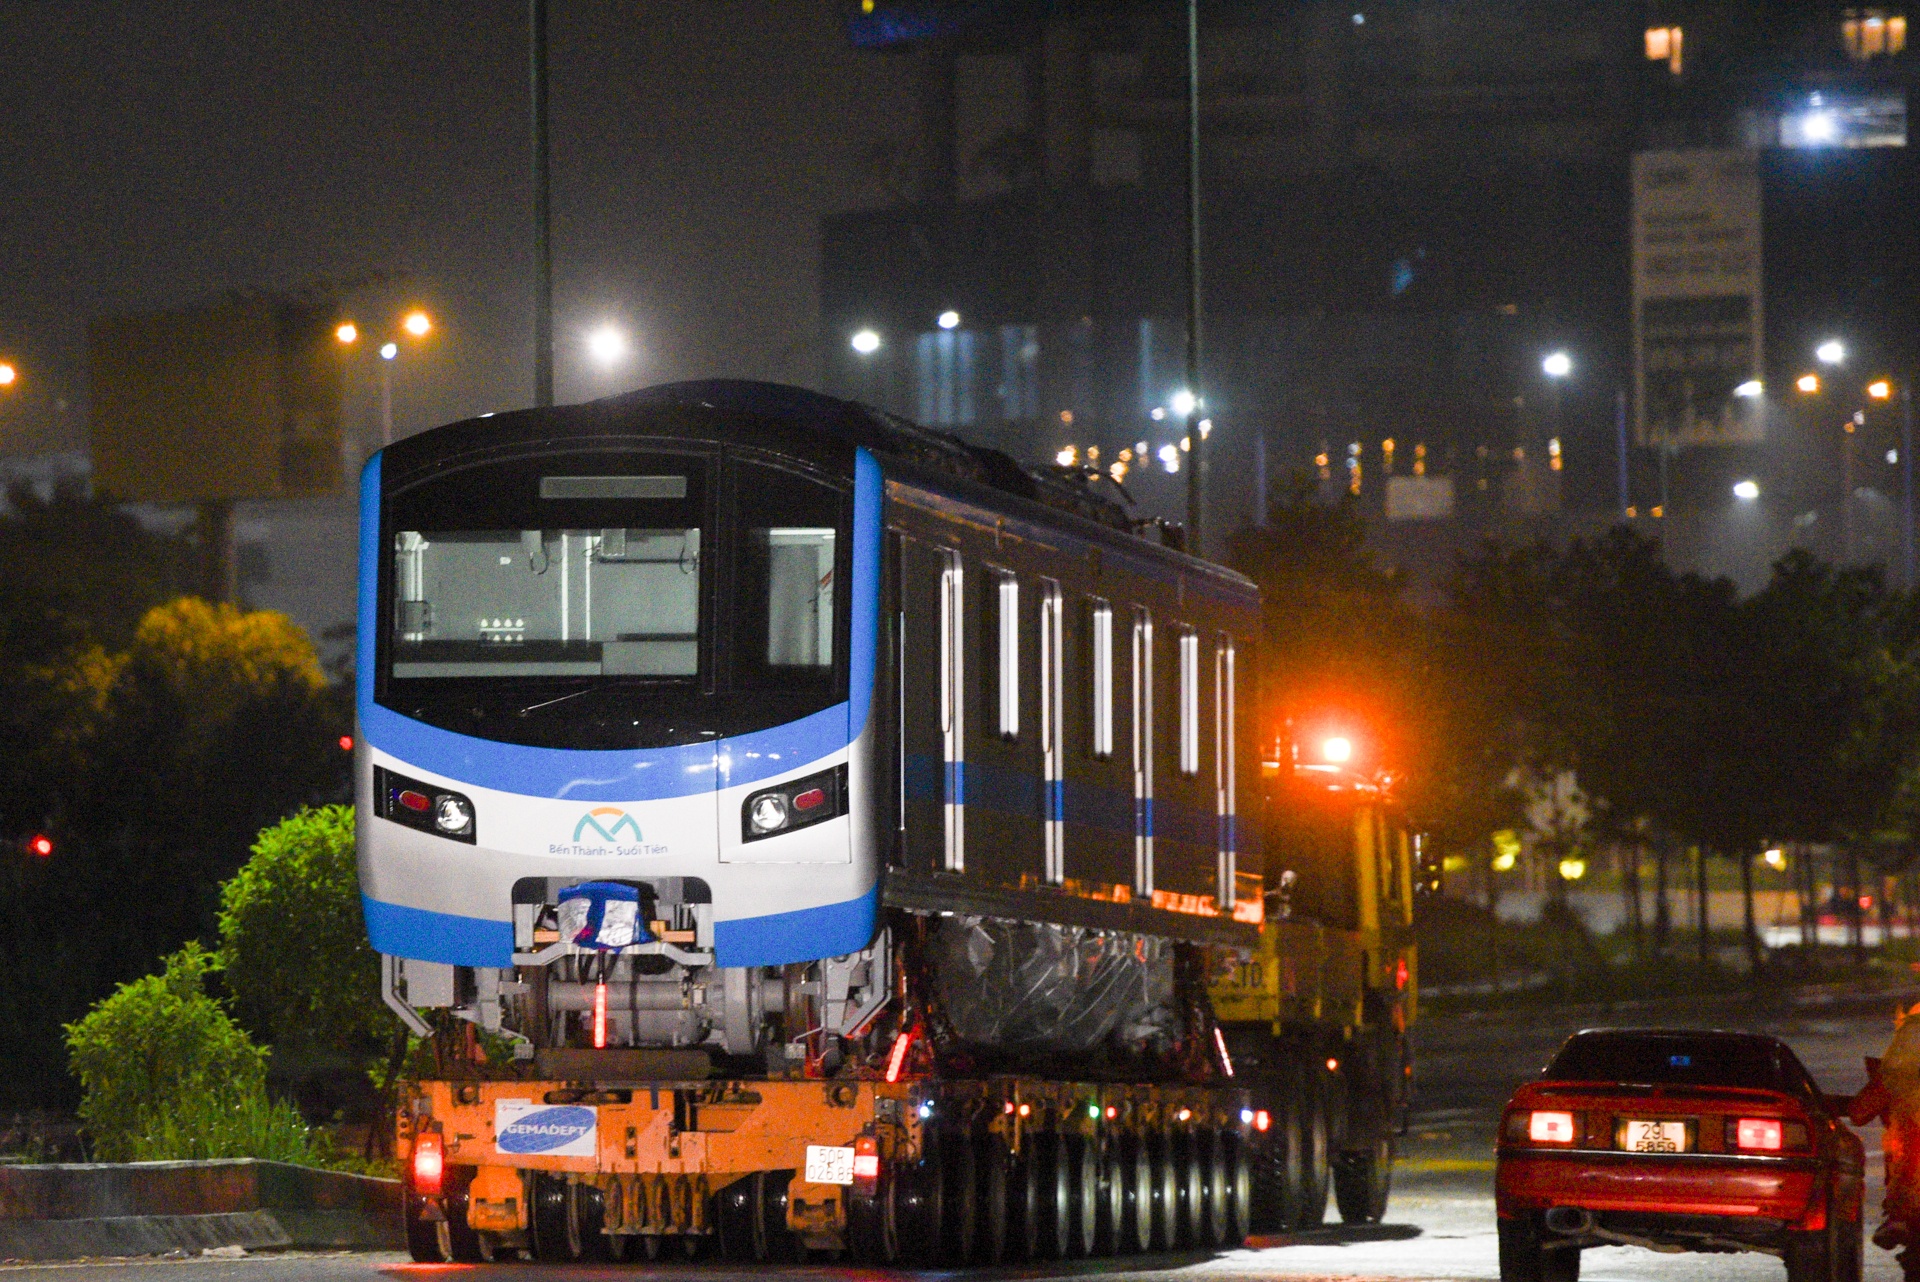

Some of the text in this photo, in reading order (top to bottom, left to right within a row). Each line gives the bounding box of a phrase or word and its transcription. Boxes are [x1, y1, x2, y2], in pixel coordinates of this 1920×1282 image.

[507, 1124, 587, 1136] GEMADEPT
[1641, 1123, 1671, 1140] 29L
[1636, 1141, 1676, 1152] 5859
[819, 1148, 845, 1164] 50R
